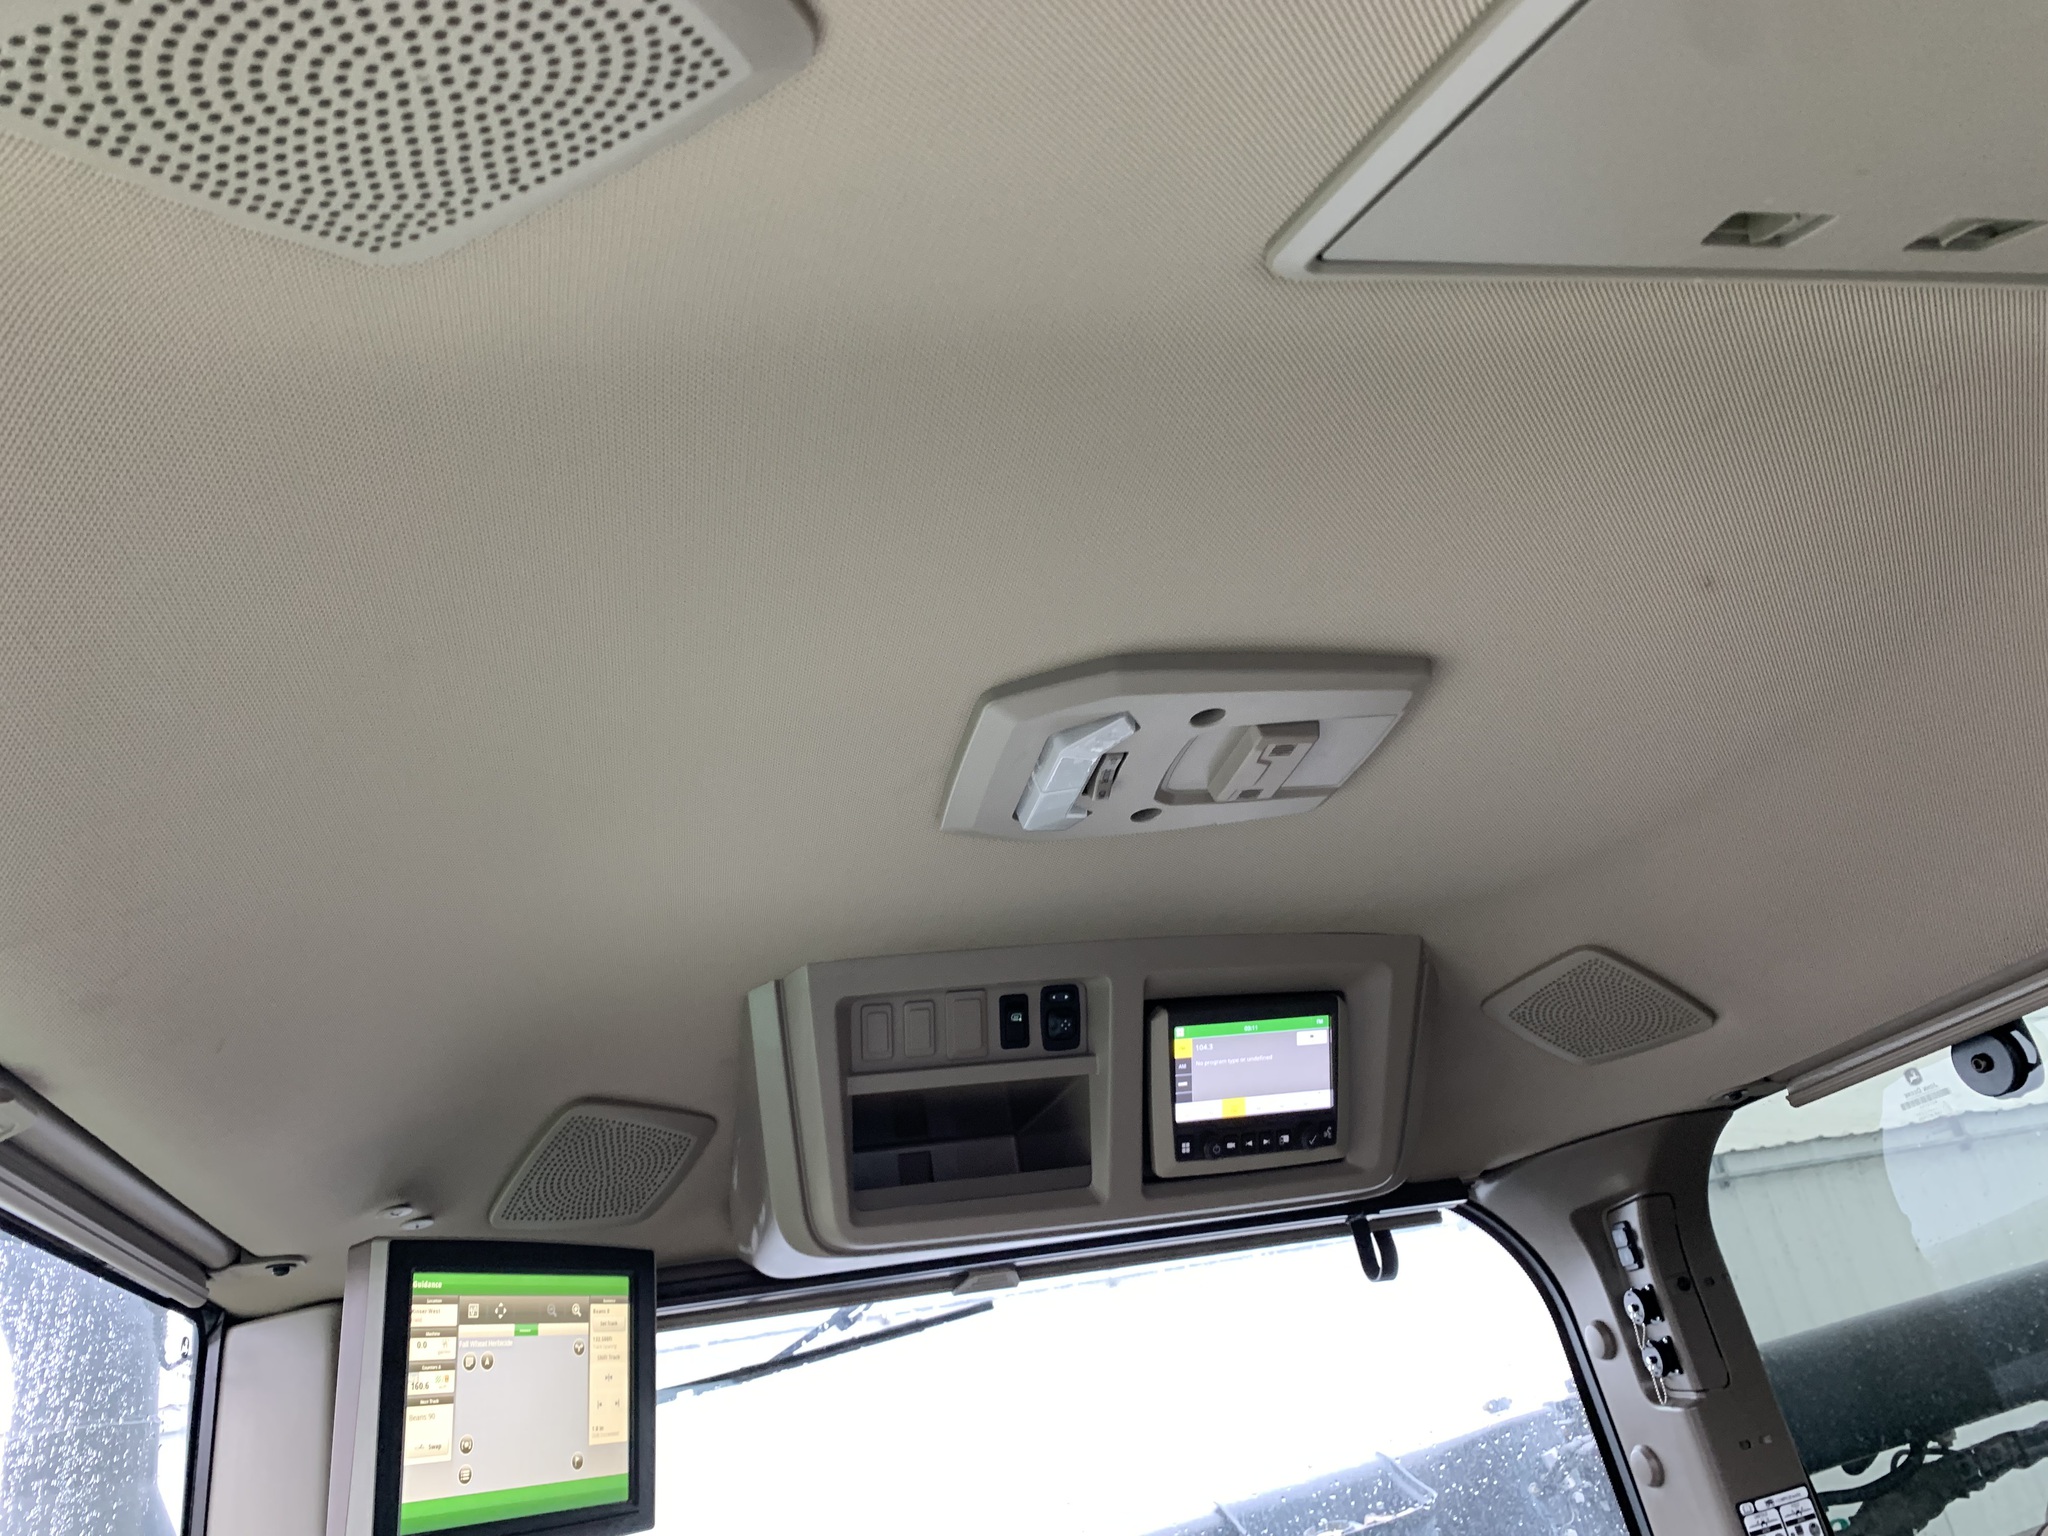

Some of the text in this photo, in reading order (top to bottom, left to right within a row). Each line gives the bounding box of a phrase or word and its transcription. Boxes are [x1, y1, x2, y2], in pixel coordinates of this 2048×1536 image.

[1196, 1043, 1213, 1051] 104.3
[1204, 1059, 1227, 1067] program
[413, 1280, 442, 1289] Guidance
[416, 1341, 428, 1349] 0.0
[411, 1381, 430, 1390] 160.6
[409, 1413, 427, 1422] Beans
